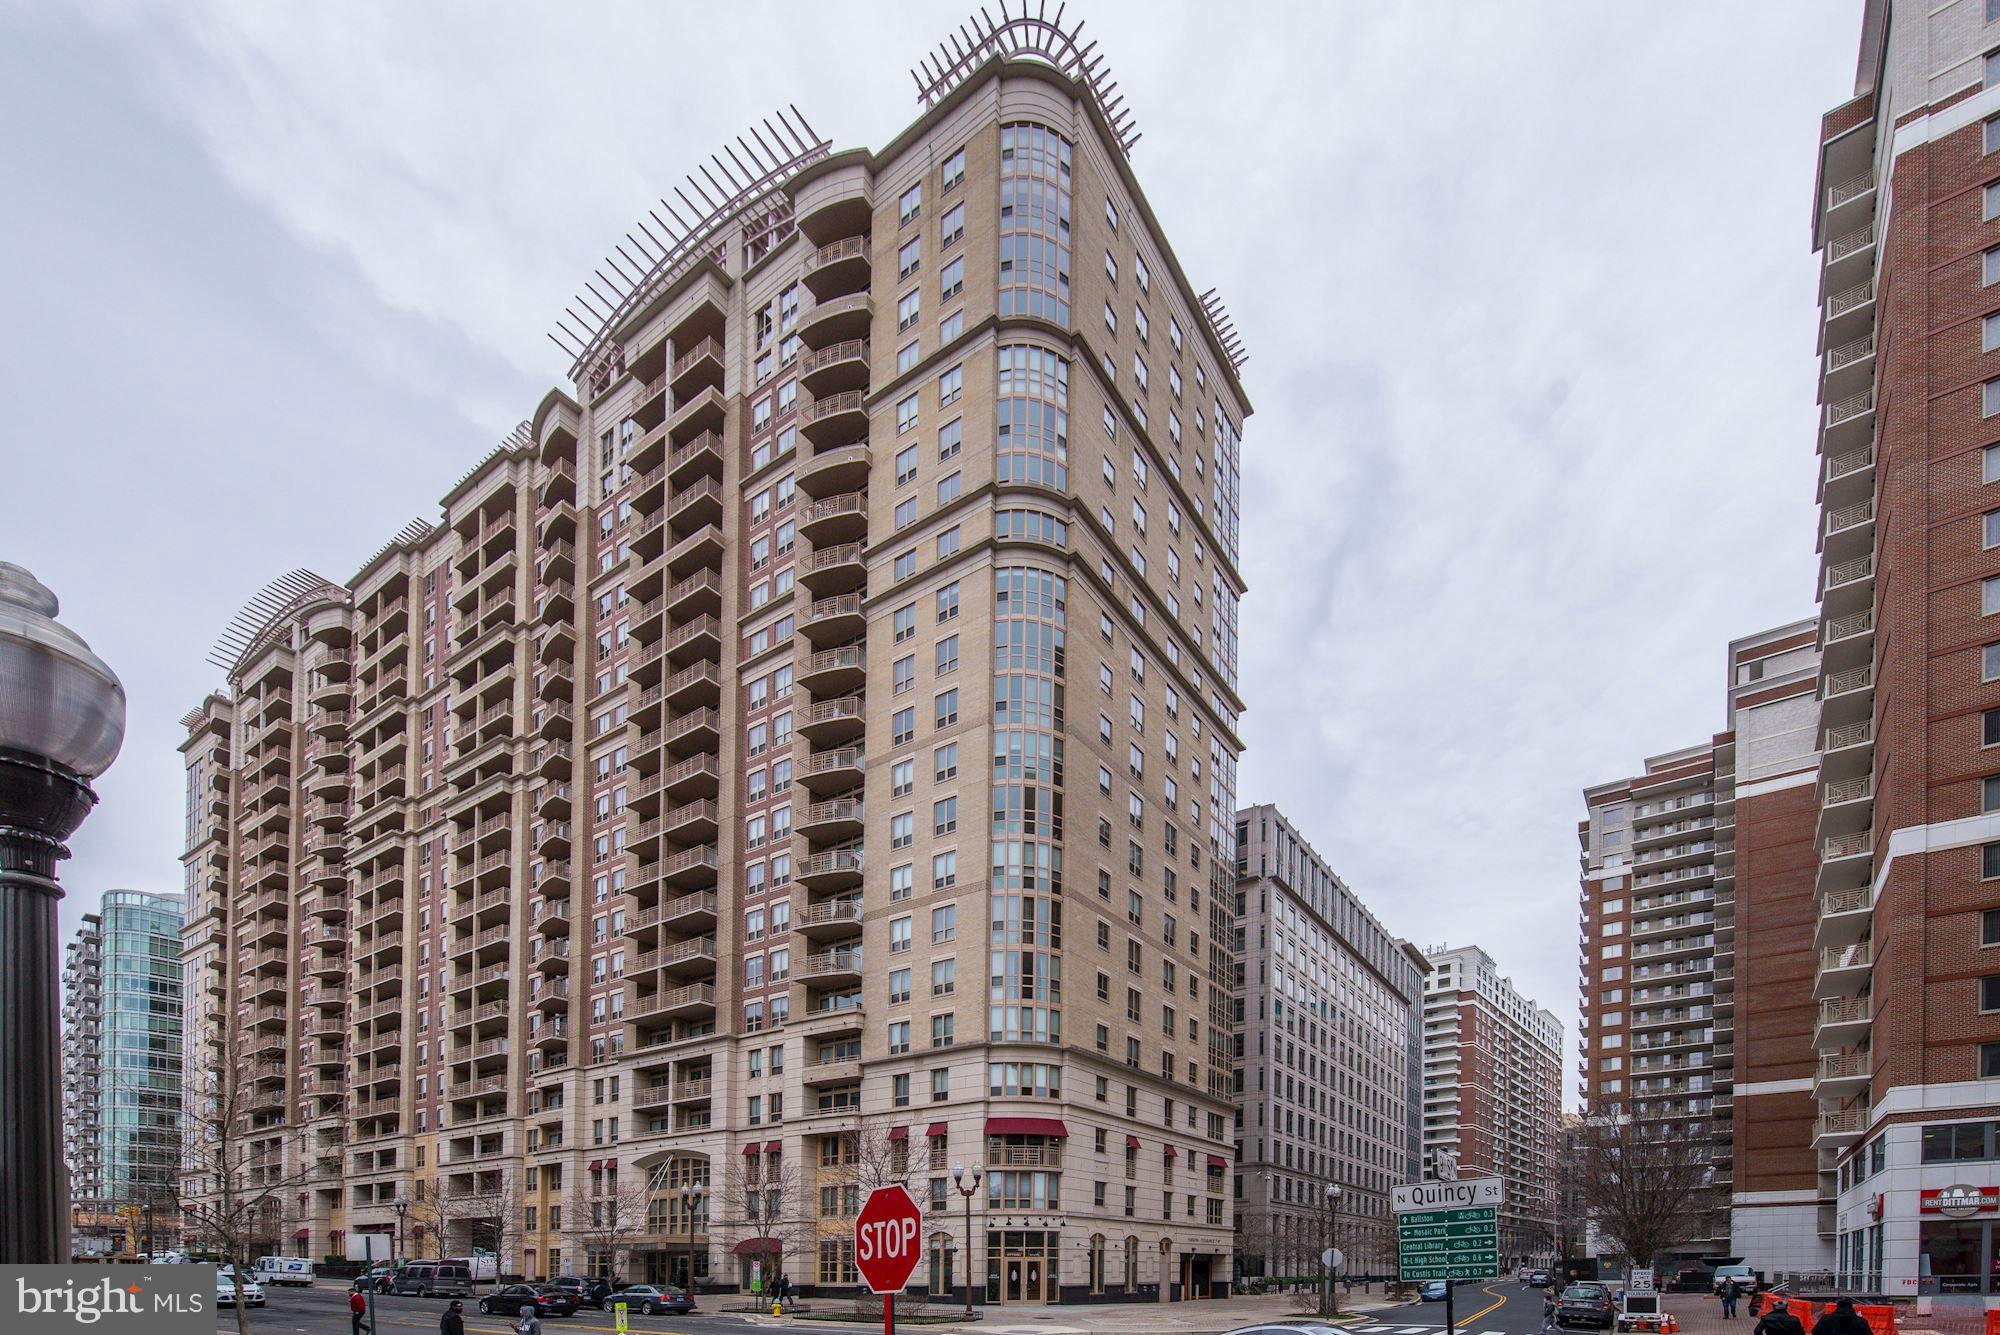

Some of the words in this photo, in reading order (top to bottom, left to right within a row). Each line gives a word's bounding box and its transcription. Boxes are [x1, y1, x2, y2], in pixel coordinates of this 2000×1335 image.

[1397, 1194, 1405, 1203] N
[1412, 1184, 1477, 1205] Quincy
[1485, 1186, 1498, 1196] St
[1410, 1215, 1434, 1223] Ballston
[1483, 1210, 1493, 1218] 0.3
[1413, 1228, 1433, 1236] Mosaic
[1434, 1227, 1447, 1235] Park
[1483, 1224, 1494, 1232] 0.2
[860, 1217, 917, 1261] STOP
[1402, 1243, 1423, 1251] Central
[1424, 1242, 1444, 1251] Library
[1414, 1256, 1428, 1265] High
[1428, 1255, 1448, 1264] School
[1411, 1270, 1431, 1278] Custis
[1433, 1269, 1447, 1277] Trail
